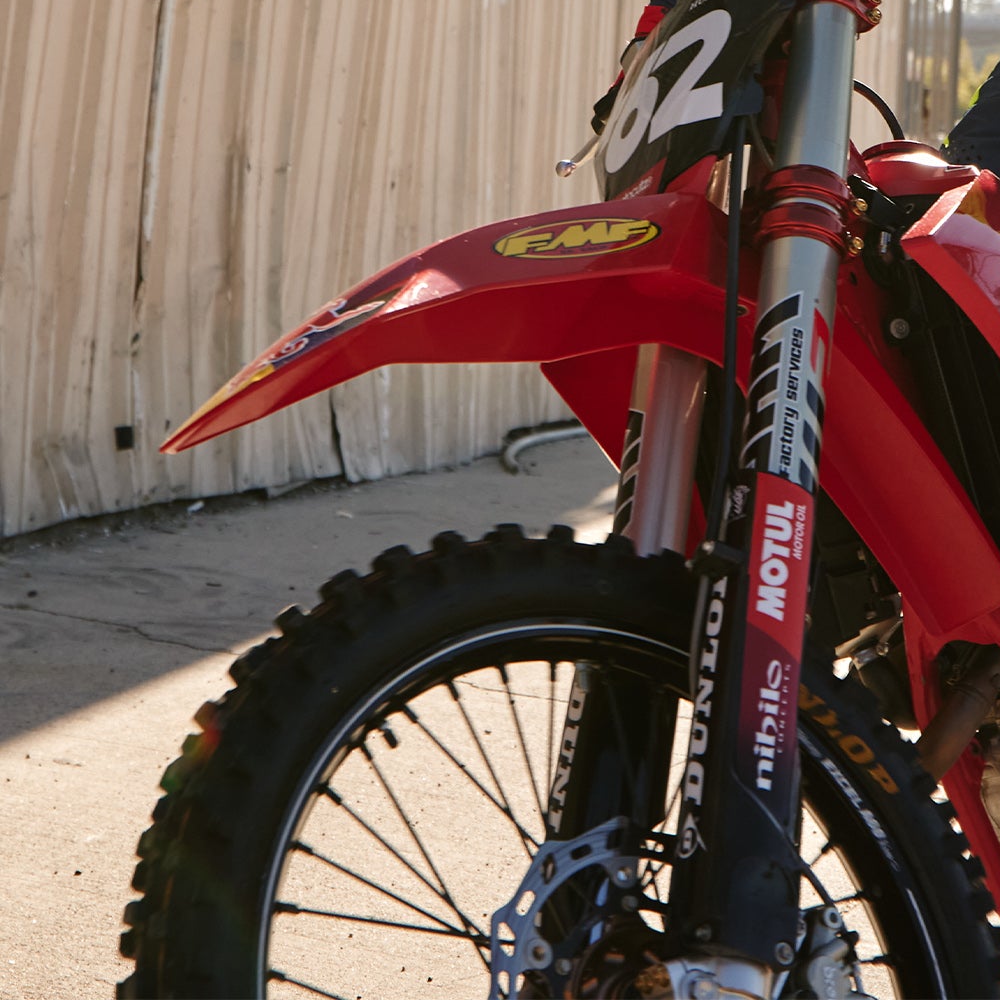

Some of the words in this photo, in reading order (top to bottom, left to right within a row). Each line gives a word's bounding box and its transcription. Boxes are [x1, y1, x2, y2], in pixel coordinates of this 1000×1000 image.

[604, 9, 732, 174] 62
[502, 220, 650, 257] FMF
[786, 328, 804, 401] services
[756, 501, 794, 620] MOTUL
